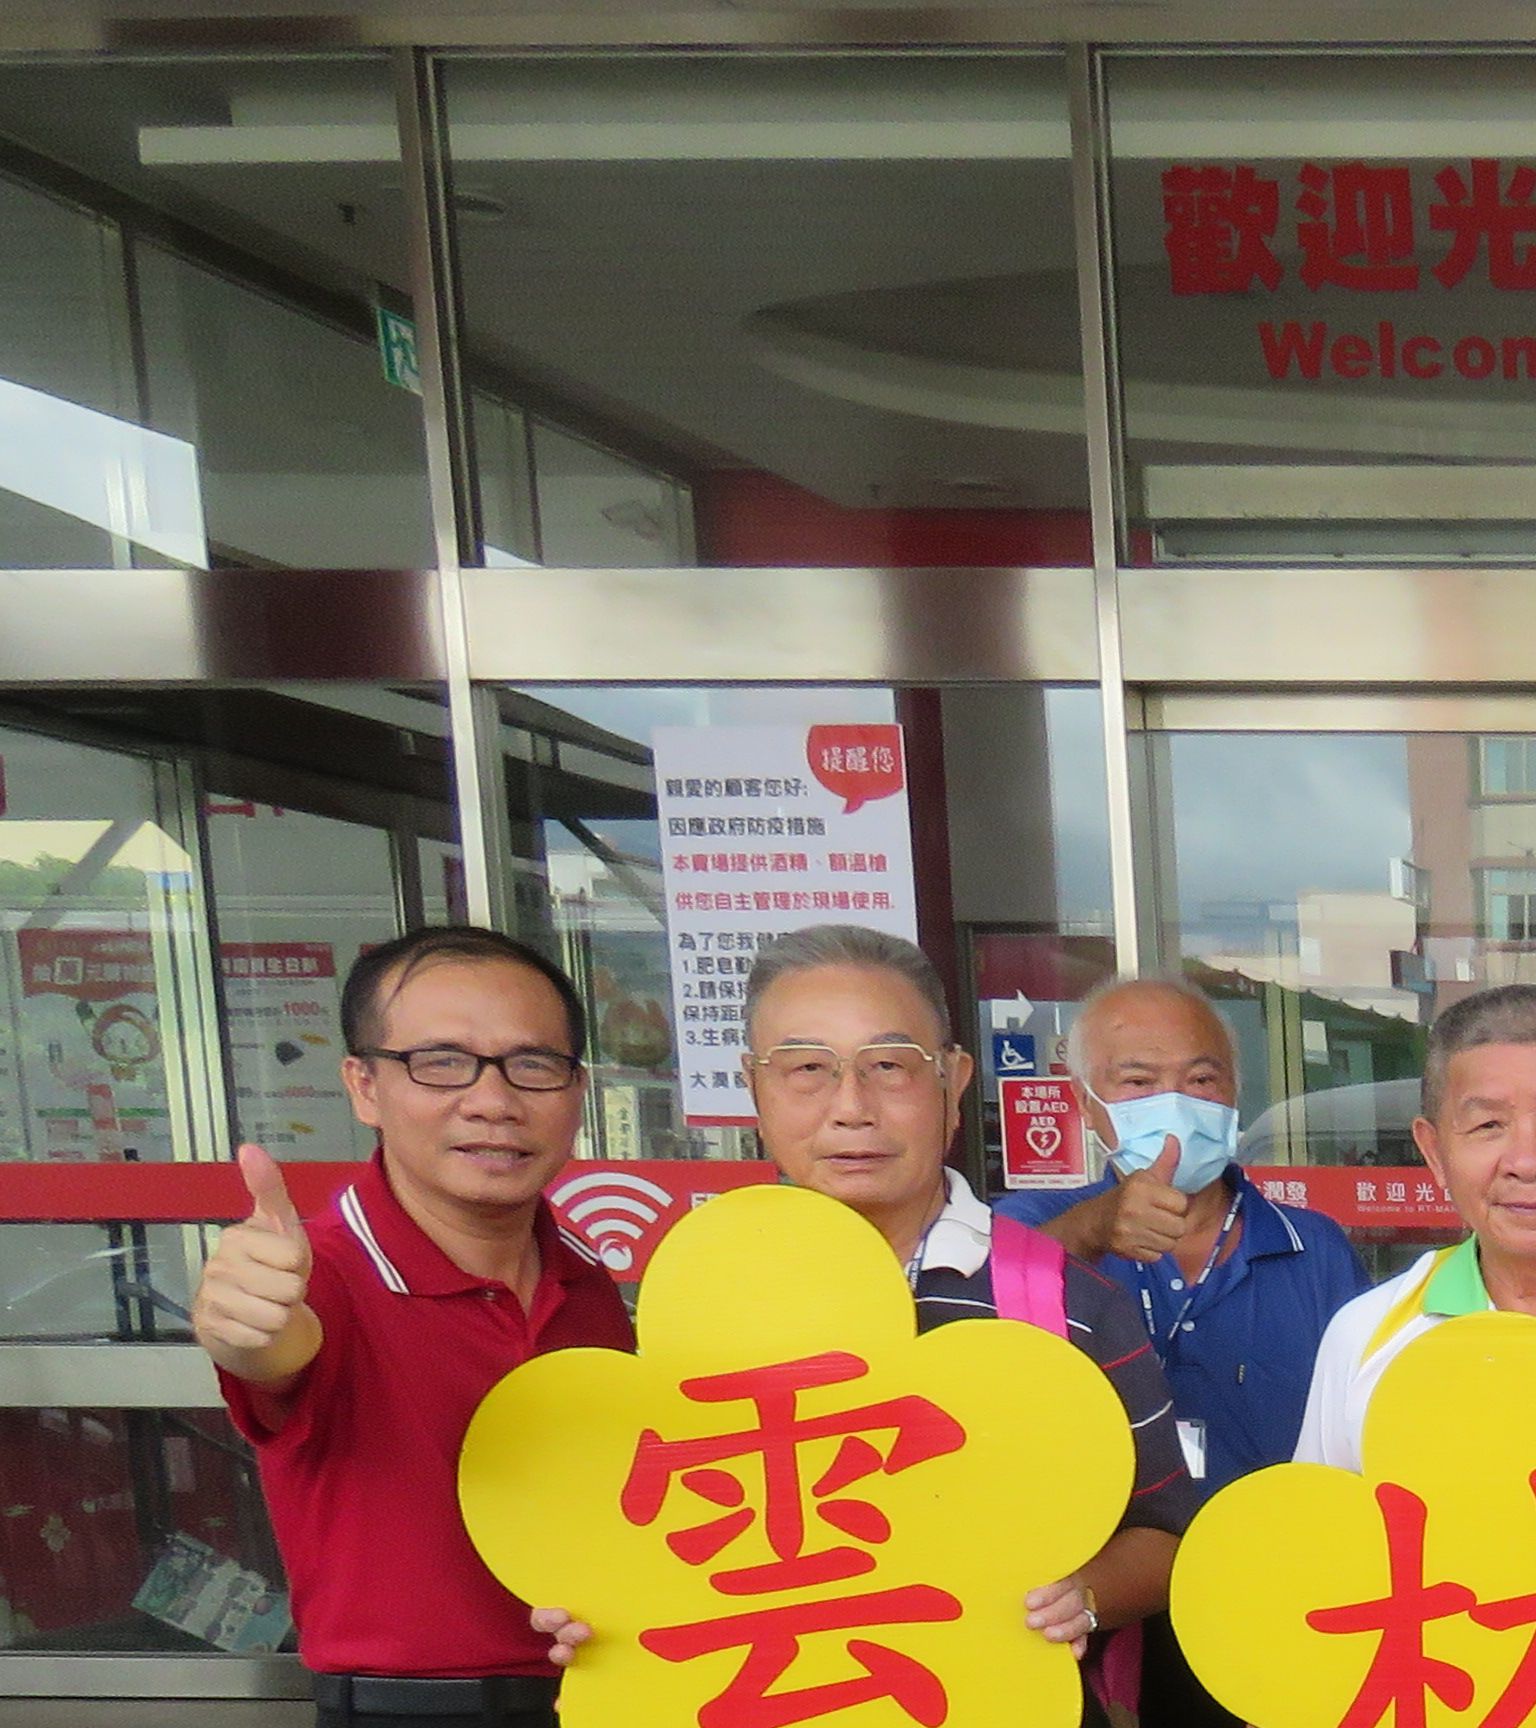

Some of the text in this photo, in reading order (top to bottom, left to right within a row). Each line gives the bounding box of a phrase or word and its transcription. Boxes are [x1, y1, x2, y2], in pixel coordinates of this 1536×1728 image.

[821, 746, 894, 774] 提醒您
[668, 816, 827, 837] 因應政府防疫措施
[673, 852, 888, 873] 本賣場提供酒精、額溫槍
[675, 890, 896, 911] 供您自主管理於現場使用.
[685, 1028, 747, 1047] 3.生病
[1256, 1180, 1308, 1201] 潤發
[1356, 1182, 1453, 1202] 歡迎光
